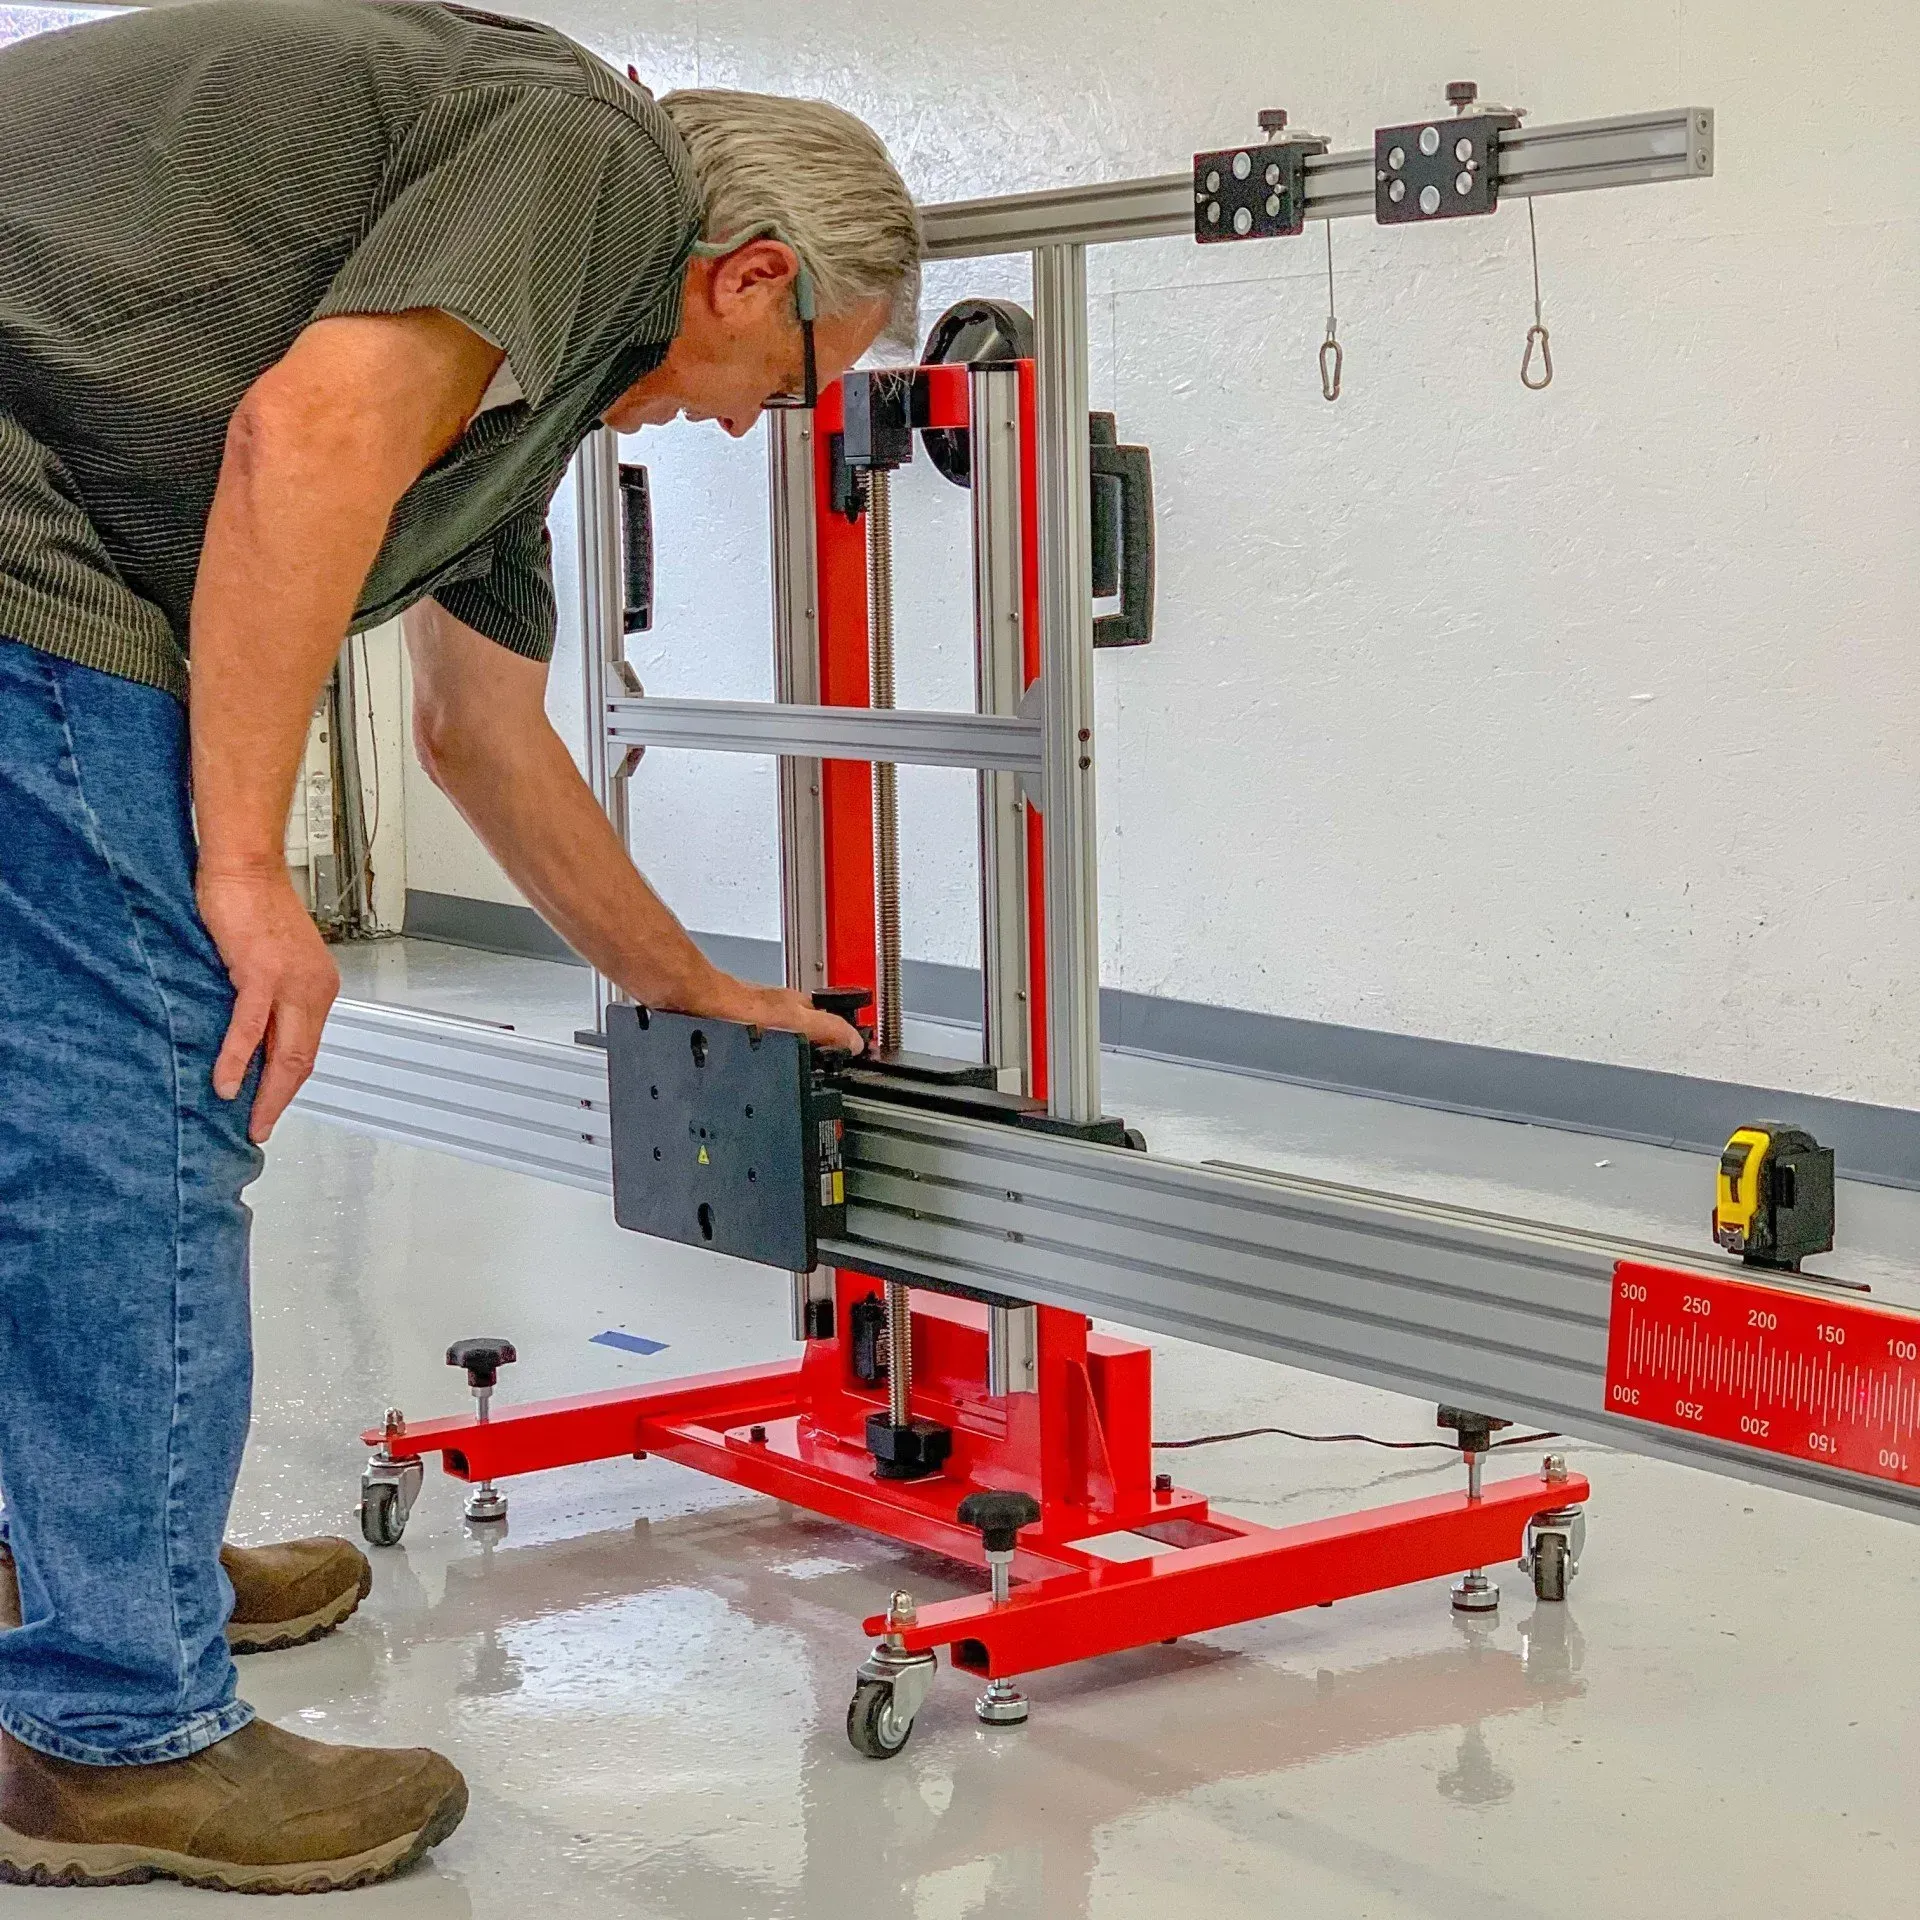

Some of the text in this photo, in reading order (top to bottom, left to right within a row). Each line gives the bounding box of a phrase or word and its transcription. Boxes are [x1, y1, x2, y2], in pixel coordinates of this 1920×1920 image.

[1621, 1282, 1917, 1361] 300 250 200 150 100
[1613, 1384, 1909, 1471] 100 150 200 250 300
